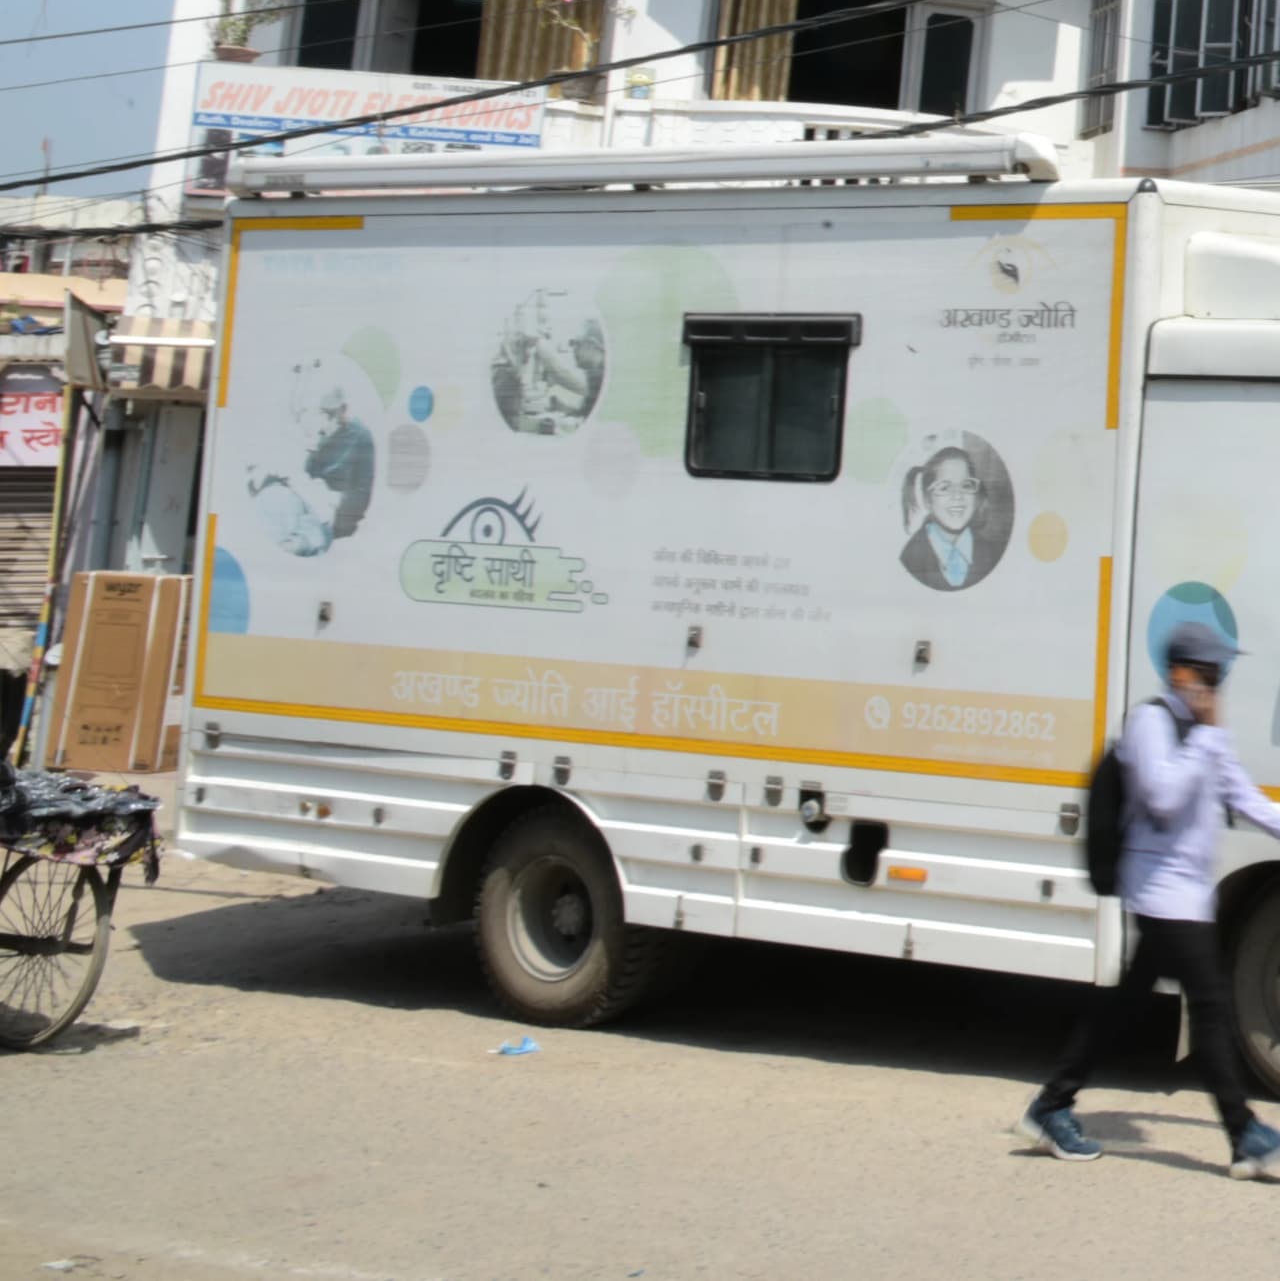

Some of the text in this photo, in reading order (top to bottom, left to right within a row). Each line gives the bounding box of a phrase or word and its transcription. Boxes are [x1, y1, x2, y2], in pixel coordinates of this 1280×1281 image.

[202, 80, 273, 111] SHIV
[275, 86, 359, 118] JYOTI
[361, 90, 540, 131] ELECTRONICS
[938, 300, 1079, 330] अखण्ड ज्योति
[430, 543, 538, 595] दृष्टि साथी
[391, 666, 783, 737] अखण्ड ज्योति आई हॉस्पीटल
[902, 701, 1057, 743] 9262892862
